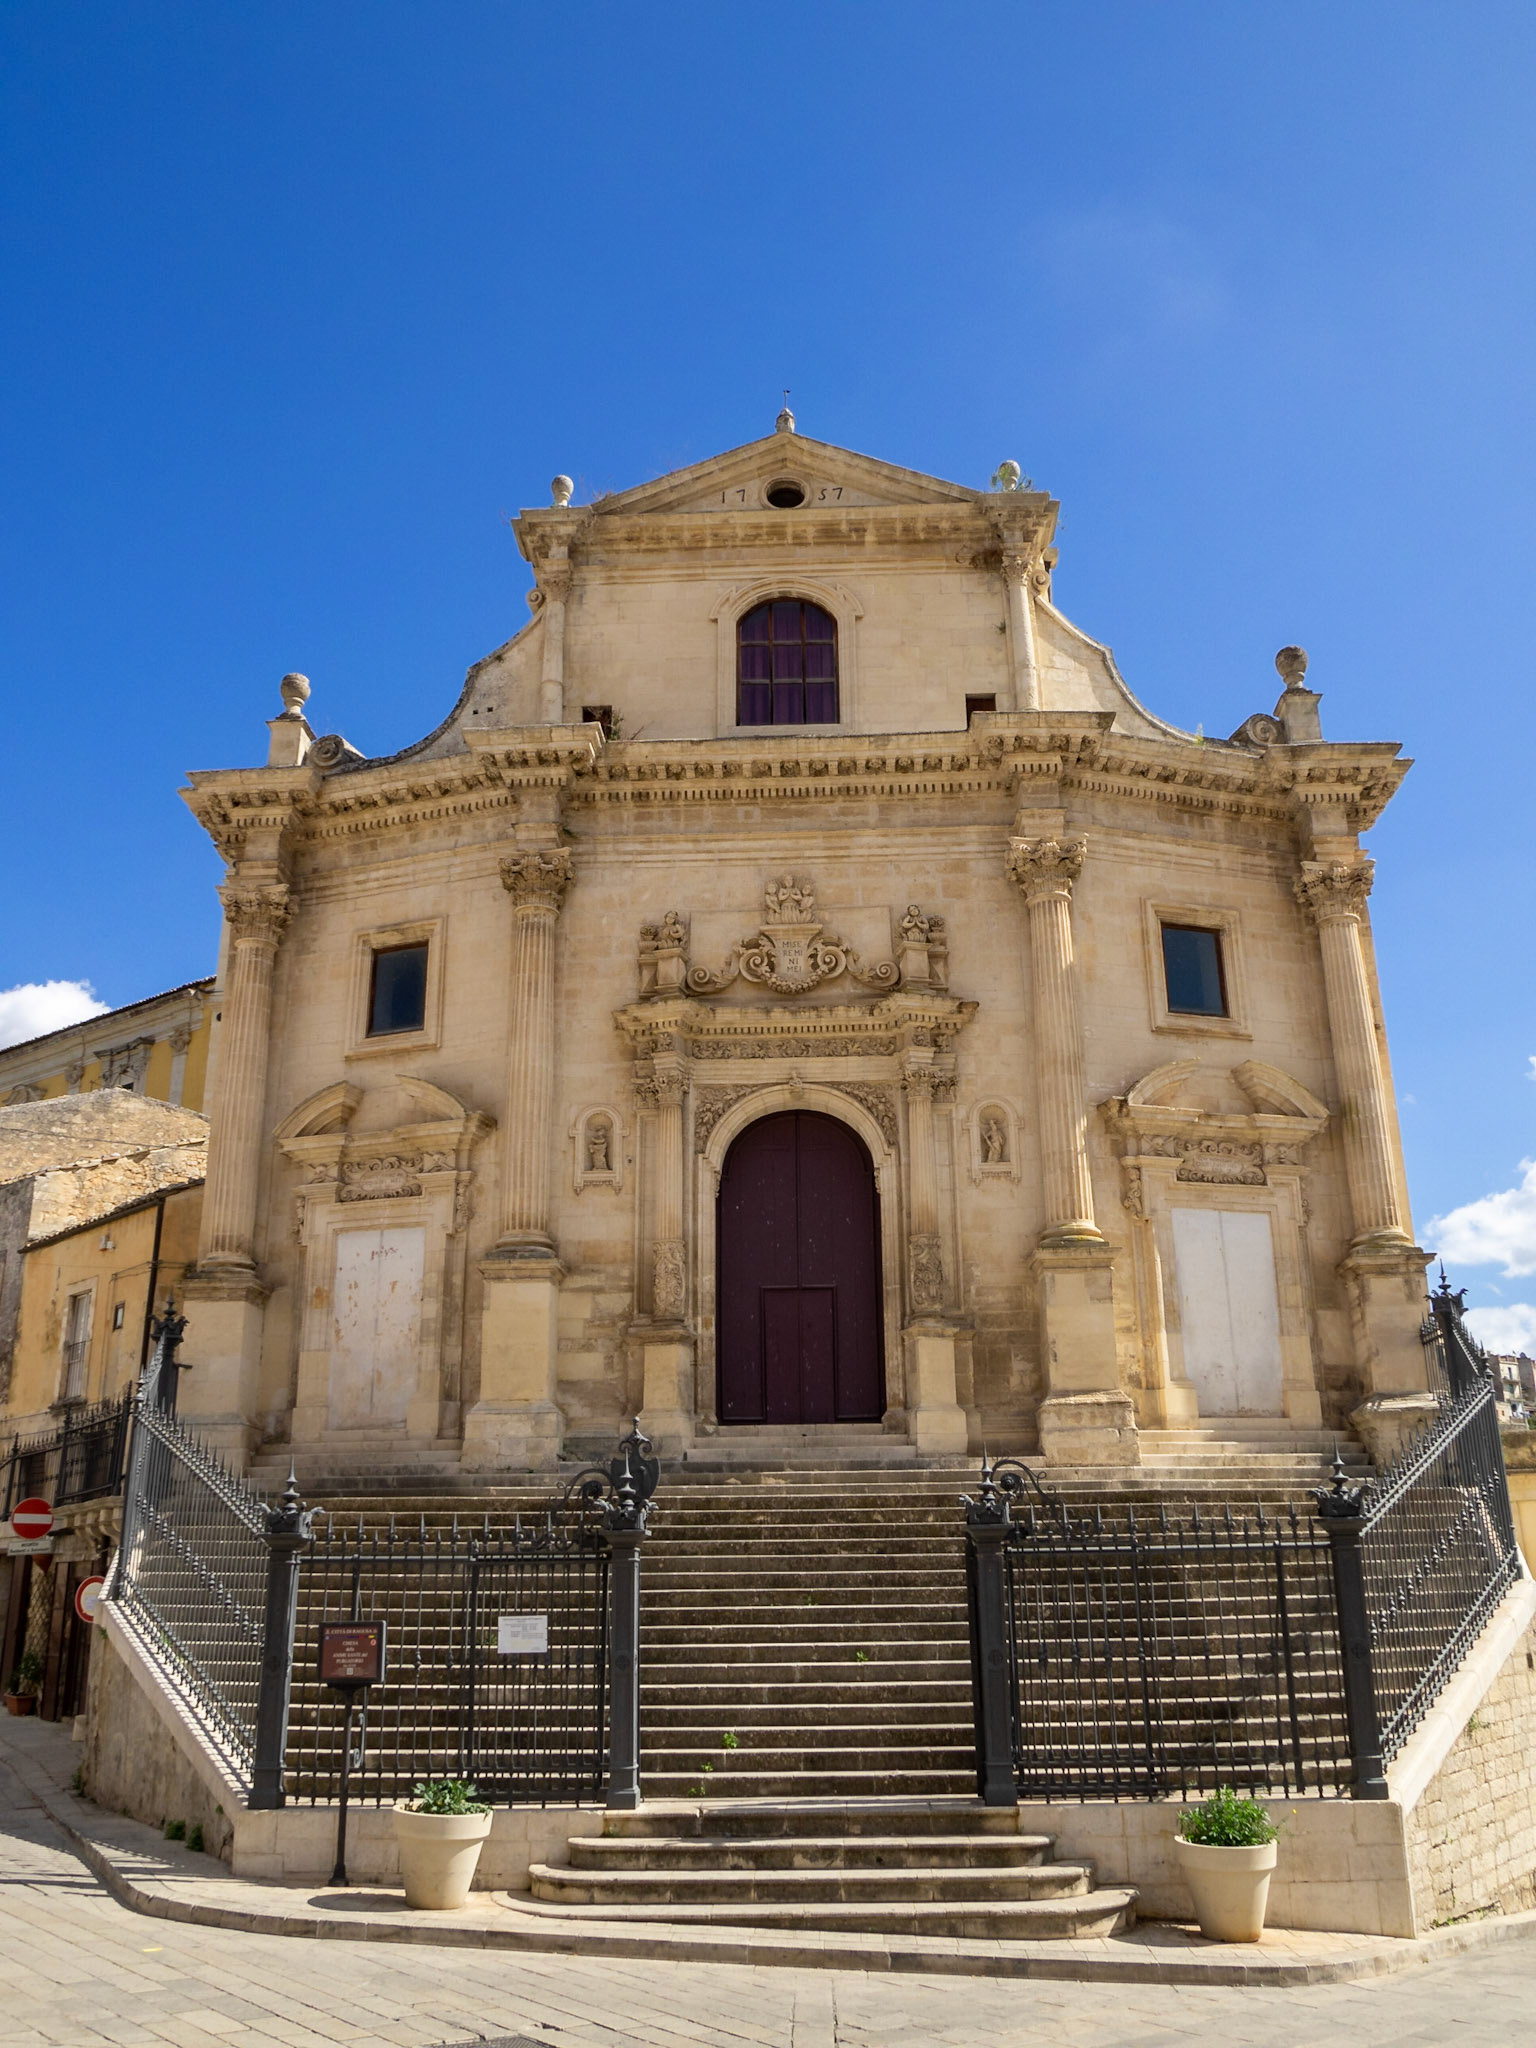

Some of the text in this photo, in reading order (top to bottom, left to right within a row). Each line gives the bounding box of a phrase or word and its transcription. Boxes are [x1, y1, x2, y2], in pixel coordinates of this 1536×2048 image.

[782, 940, 802, 948] MISE
[783, 949, 803, 957] REMI
[788, 957, 799, 965] NI
[786, 965, 802, 973] MEI
